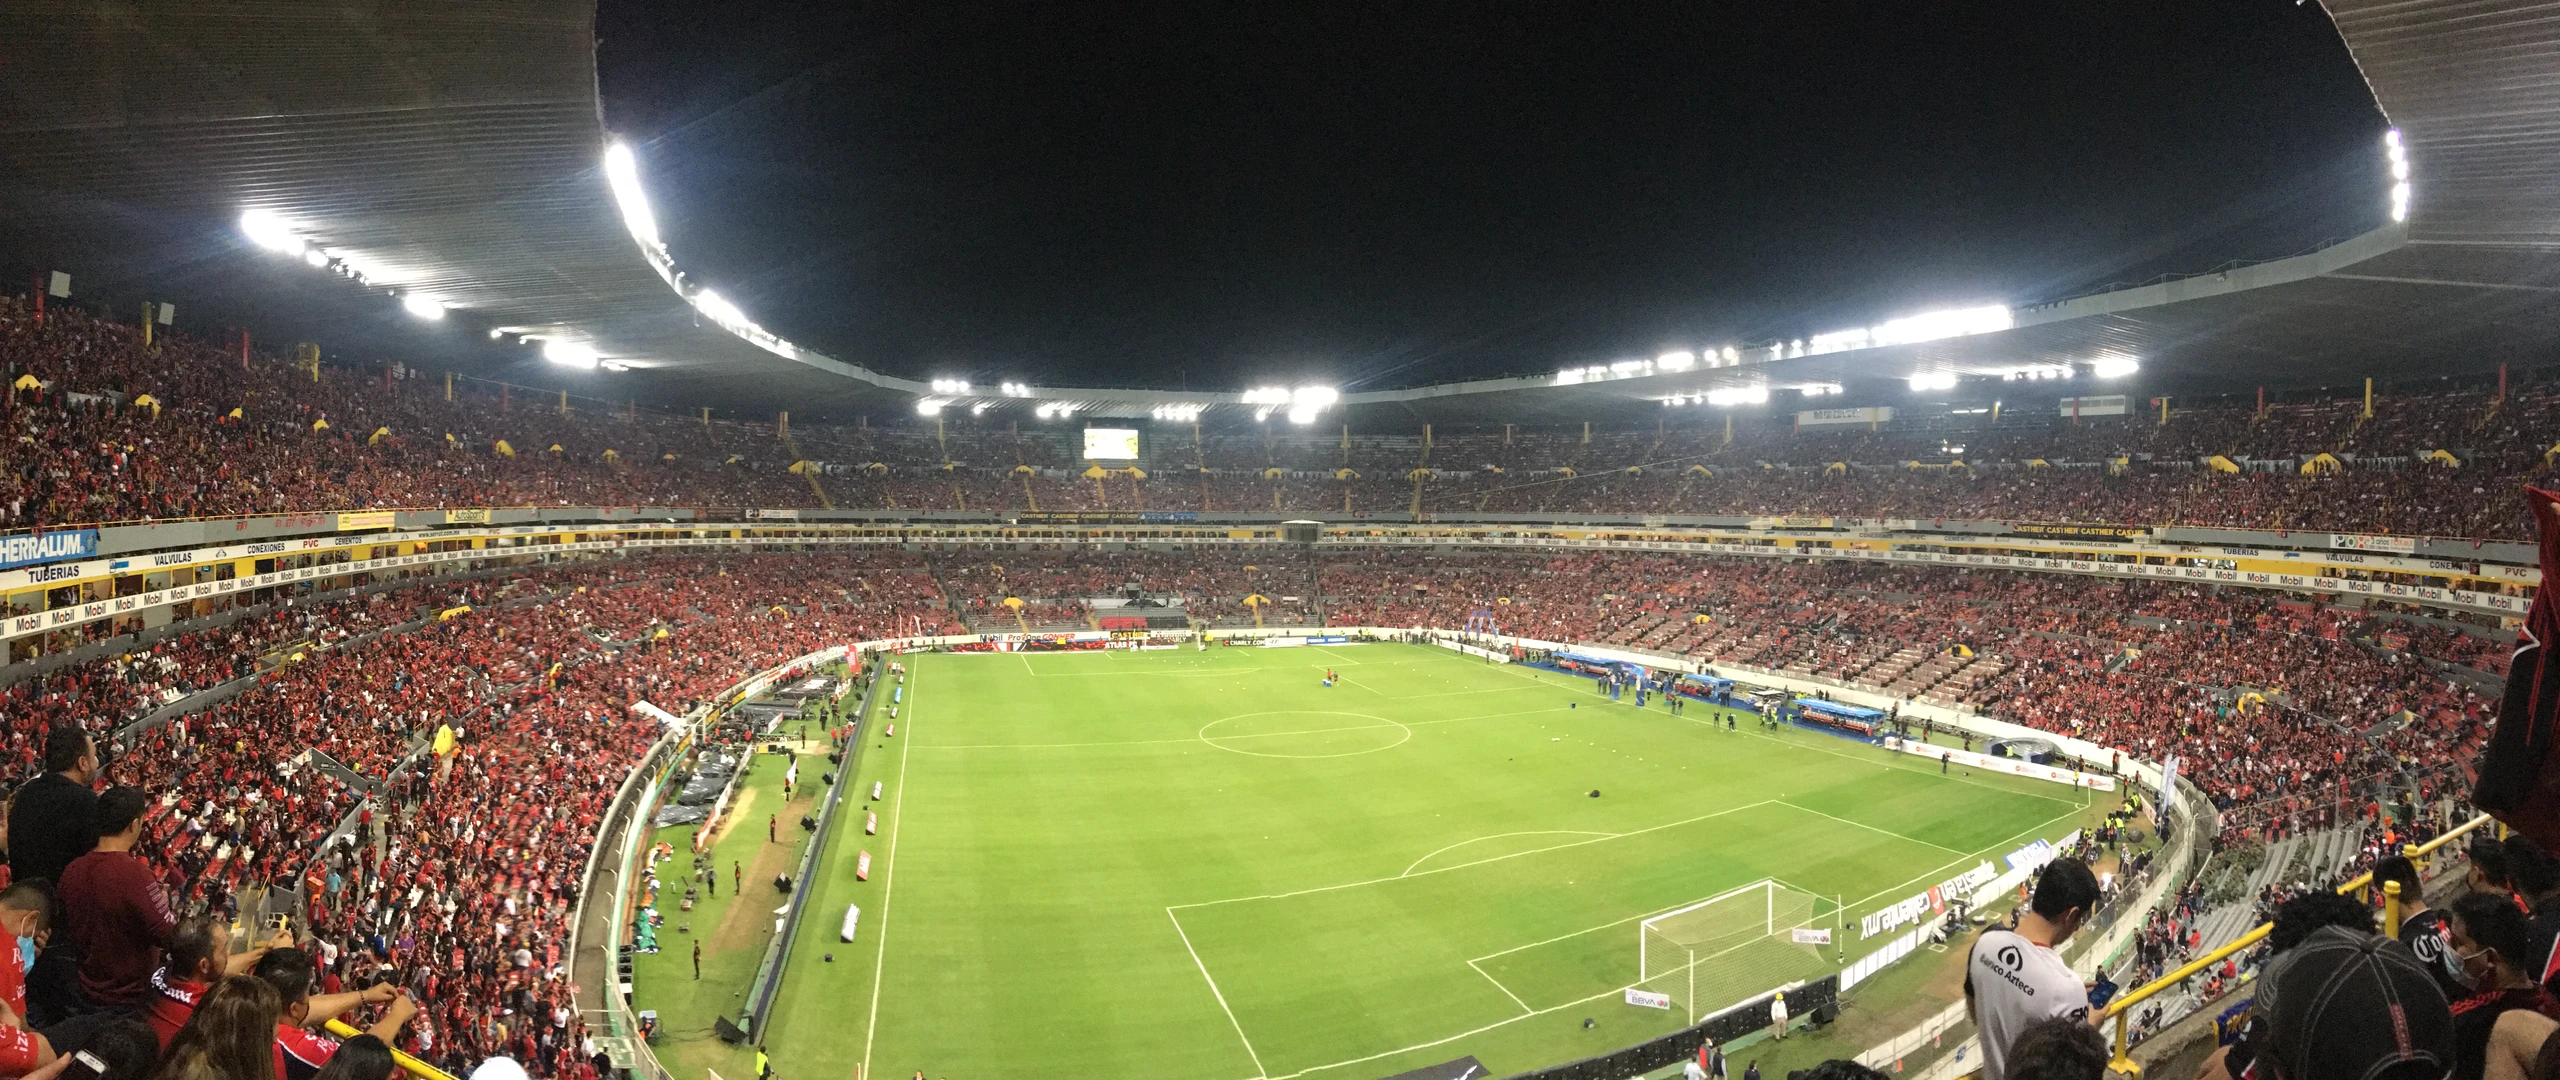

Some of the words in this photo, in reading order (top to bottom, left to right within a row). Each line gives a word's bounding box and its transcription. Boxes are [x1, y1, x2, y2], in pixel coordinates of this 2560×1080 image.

[2081, 527, 2114, 535] CASTHER
[303, 540, 319, 549] PVC
[335, 536, 362, 546] CEMENTOS
[2059, 540, 2118, 548] www.serrot.com.mx
[0, 534, 81, 563] HERRALUM
[247, 543, 285, 554] CONEXIONES
[2223, 548, 2259, 556] TUBERIAS
[154, 552, 192, 566] VALVULAS
[386, 556, 398, 566] Mobil
[403, 555, 414, 564] Mobil
[418, 554, 429, 562] Mobil
[433, 552, 443, 561] Mobil
[1915, 553, 1932, 561] Mobil
[1940, 554, 1957, 562] Mobil
[1992, 556, 2010, 565] Mobil
[2326, 554, 2364, 563] VALVULAS
[336, 563, 349, 572] Mobil
[353, 561, 366, 570] Mobil
[371, 557, 382, 568] Mobil
[2044, 560, 2063, 568] Mobil
[2071, 561, 2090, 570] Mobil
[2099, 563, 2118, 572] Mobil
[29, 565, 80, 584] TUBERIAS
[300, 568, 314, 578] Mobil
[318, 565, 332, 575] Mobil
[2127, 565, 2146, 574] Mobil
[2156, 567, 2176, 576] Mobil
[2185, 569, 2206, 578] Mobil
[2505, 567, 2527, 577] PVC
[261, 573, 275, 585] Mobil
[281, 570, 295, 582] Mobil
[2215, 571, 2237, 580] Mobil
[2247, 573, 2270, 583] Mobil
[2280, 575, 2303, 586] Mobil
[218, 580, 235, 592] Mobil
[240, 576, 255, 588] Mobil
[2314, 578, 2338, 589] Mobil
[2349, 581, 2372, 592] Mobil
[171, 587, 189, 600] Mobil
[195, 584, 212, 596] Mobil
[2383, 583, 2407, 596] Mobil
[2418, 588, 2442, 599] Mobil
[144, 592, 163, 605] Mobil
[2454, 592, 2477, 604] Mobil
[2488, 595, 2512, 609] Mobil
[115, 597, 136, 611] Mobil
[85, 603, 107, 618] Mobil
[52, 610, 75, 624] Mobil
[16, 617, 42, 632] Mobil
[1860, 892, 1930, 940] caliente.mx
[2004, 970, 2035, 997] Azteca
[1632, 996, 1656, 1006] BBVA
